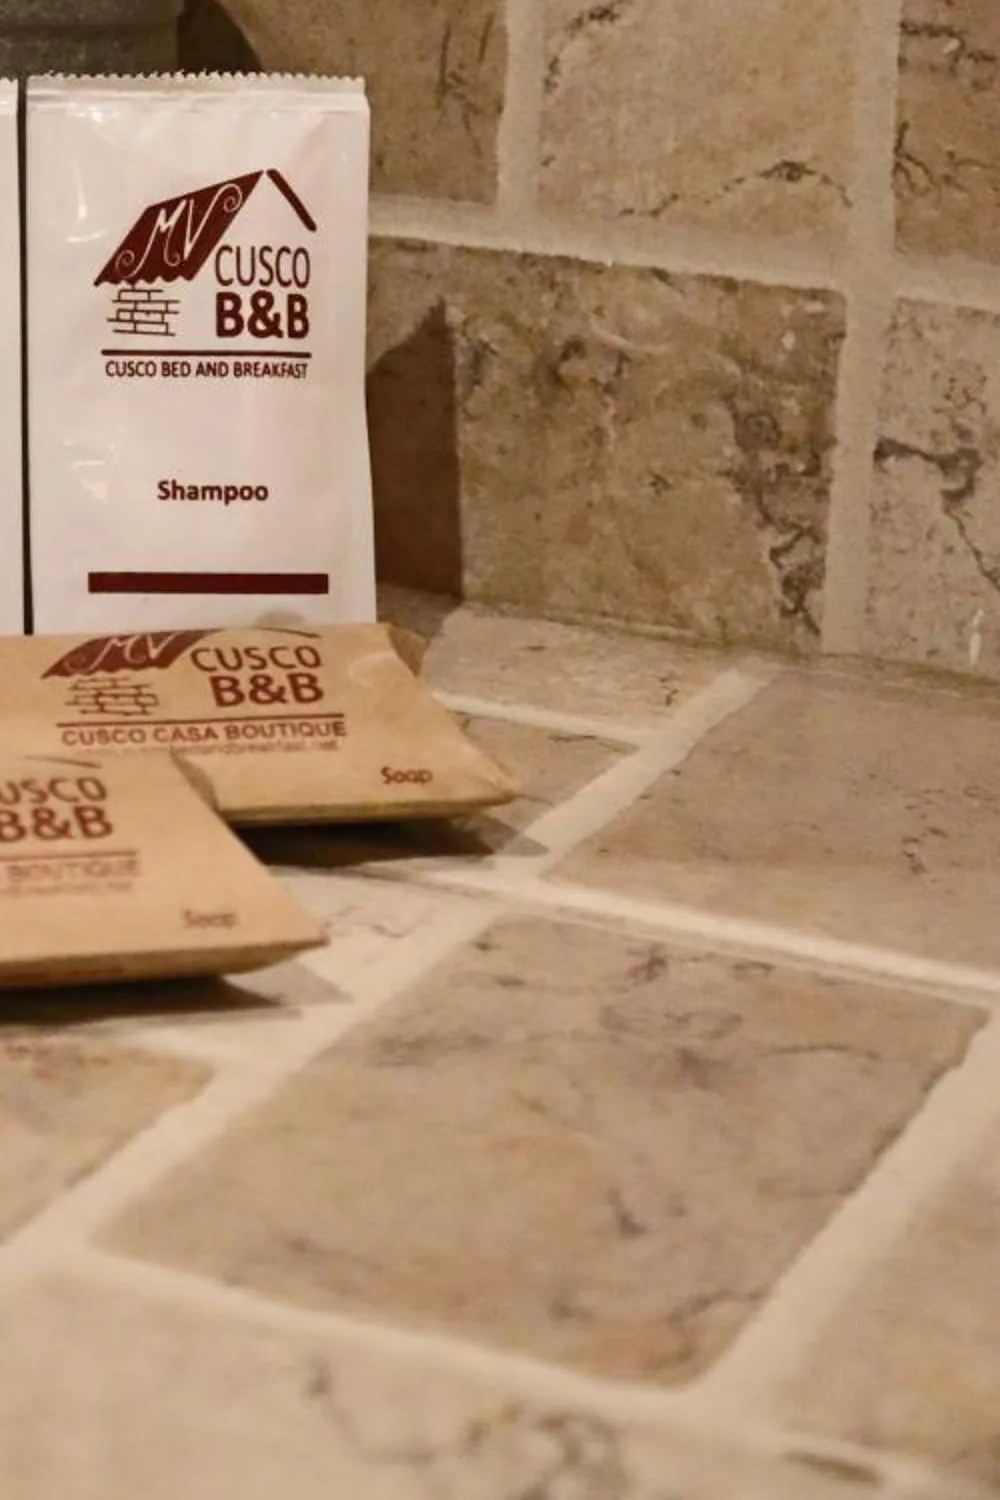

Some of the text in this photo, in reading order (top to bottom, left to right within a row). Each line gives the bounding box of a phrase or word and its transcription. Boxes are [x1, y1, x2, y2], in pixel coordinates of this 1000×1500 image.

[214, 244, 310, 288] CUSCO
[215, 291, 310, 340] B&B
[105, 360, 309, 379] CUSCO BED AND BREAKFAST
[157, 480, 269, 505] Shampoo
[190, 645, 322, 673] CUSCO
[209, 672, 324, 708] B&B
[61, 720, 347, 747] CUSCO CASA BOUTIQUE
[380, 766, 434, 787] Soap
